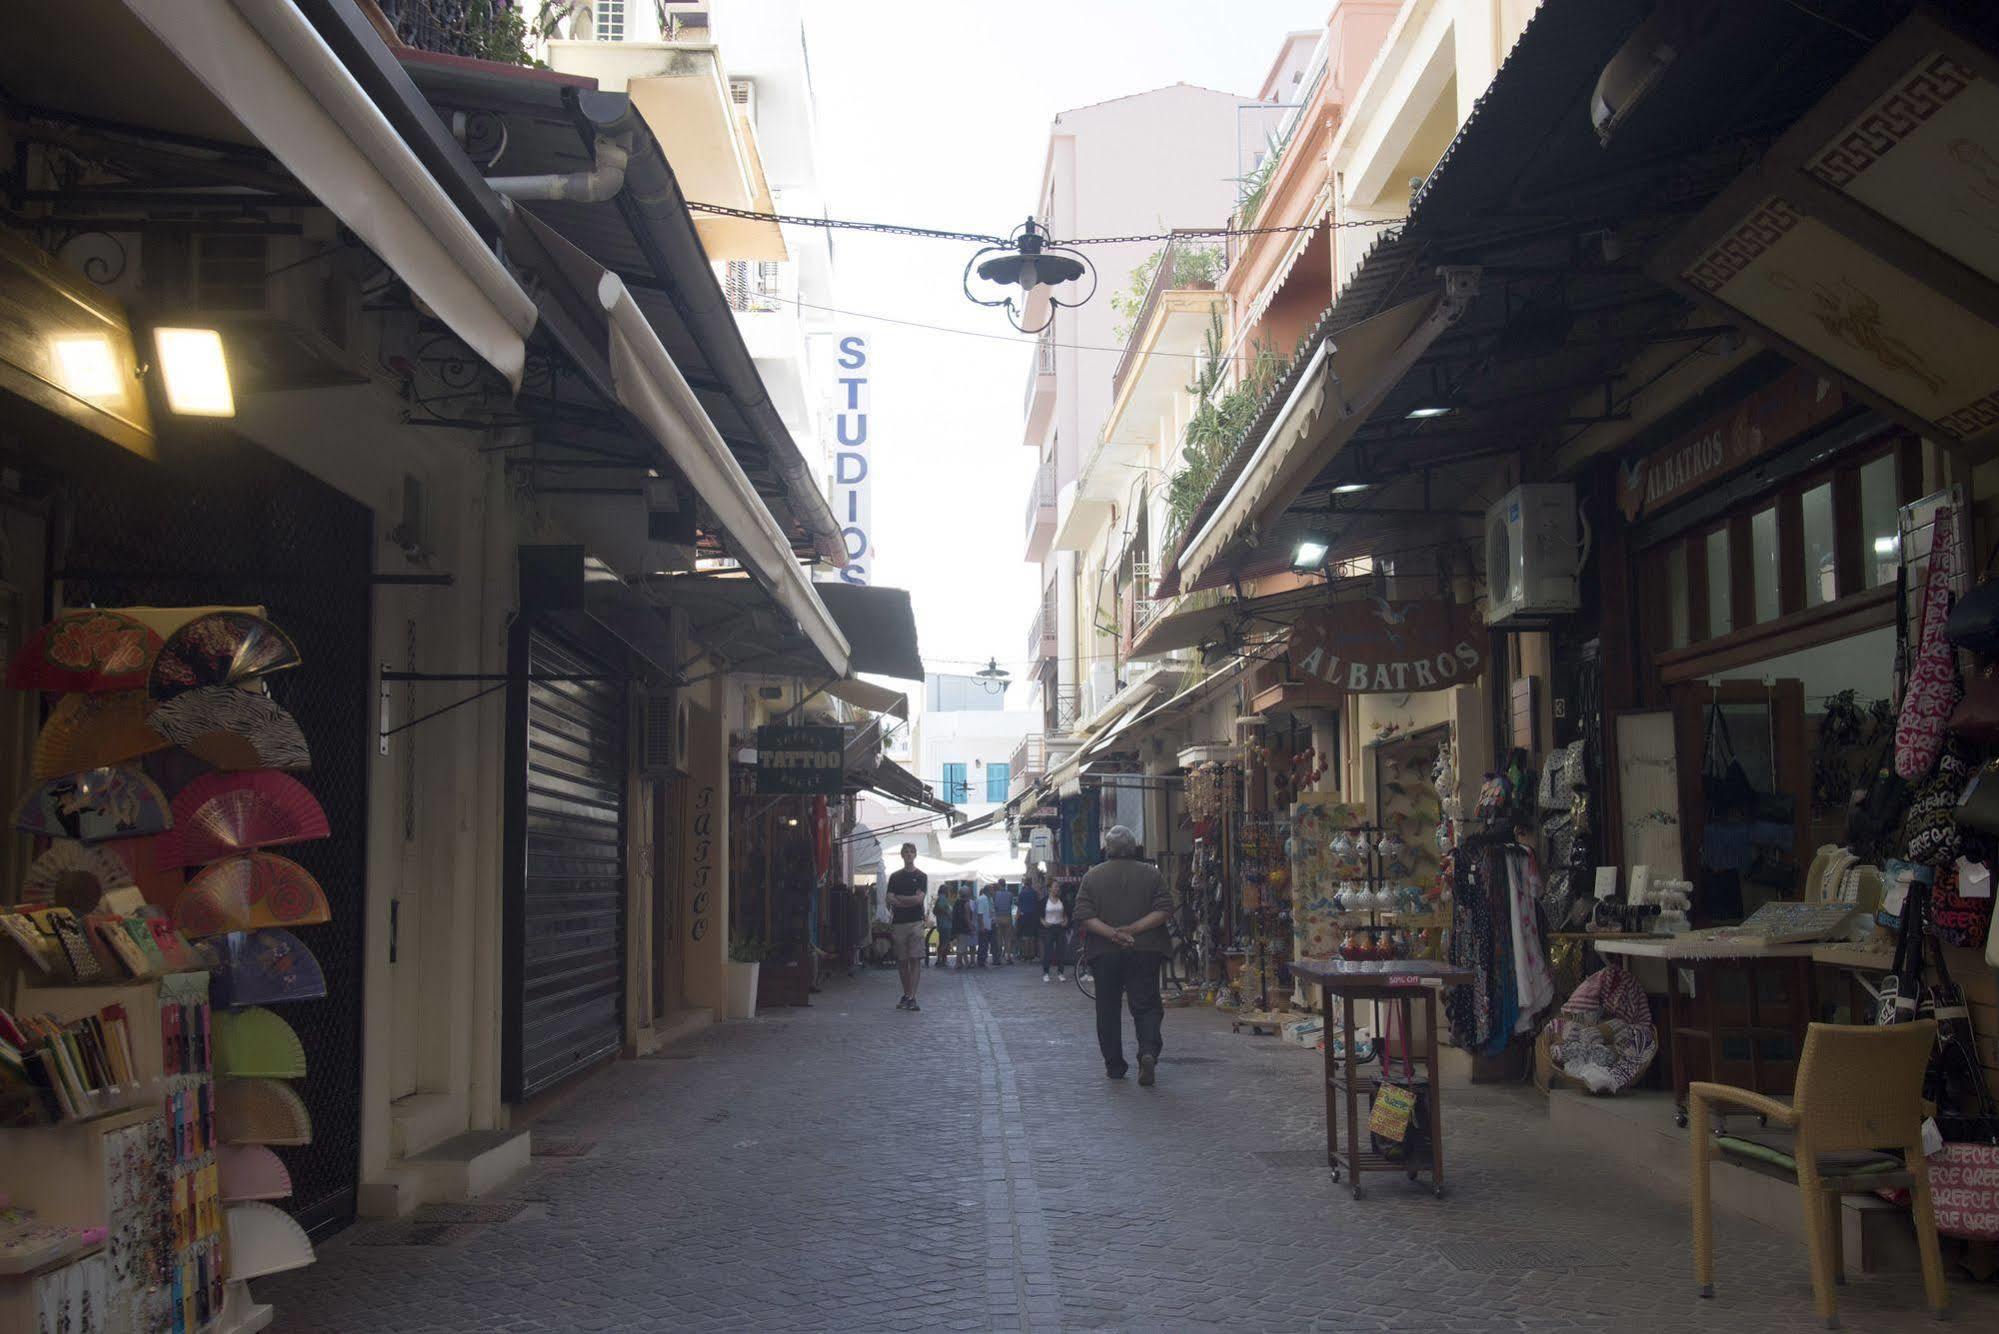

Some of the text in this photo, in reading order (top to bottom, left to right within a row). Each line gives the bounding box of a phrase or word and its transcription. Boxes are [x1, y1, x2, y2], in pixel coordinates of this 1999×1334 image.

[836, 336, 868, 585] STUDIOS
[1647, 429, 1723, 503] ALBATROS
[1299, 641, 1480, 689] ALBATROS
[759, 750, 840, 769] TATTOO
[691, 786, 714, 942] TATTOO
